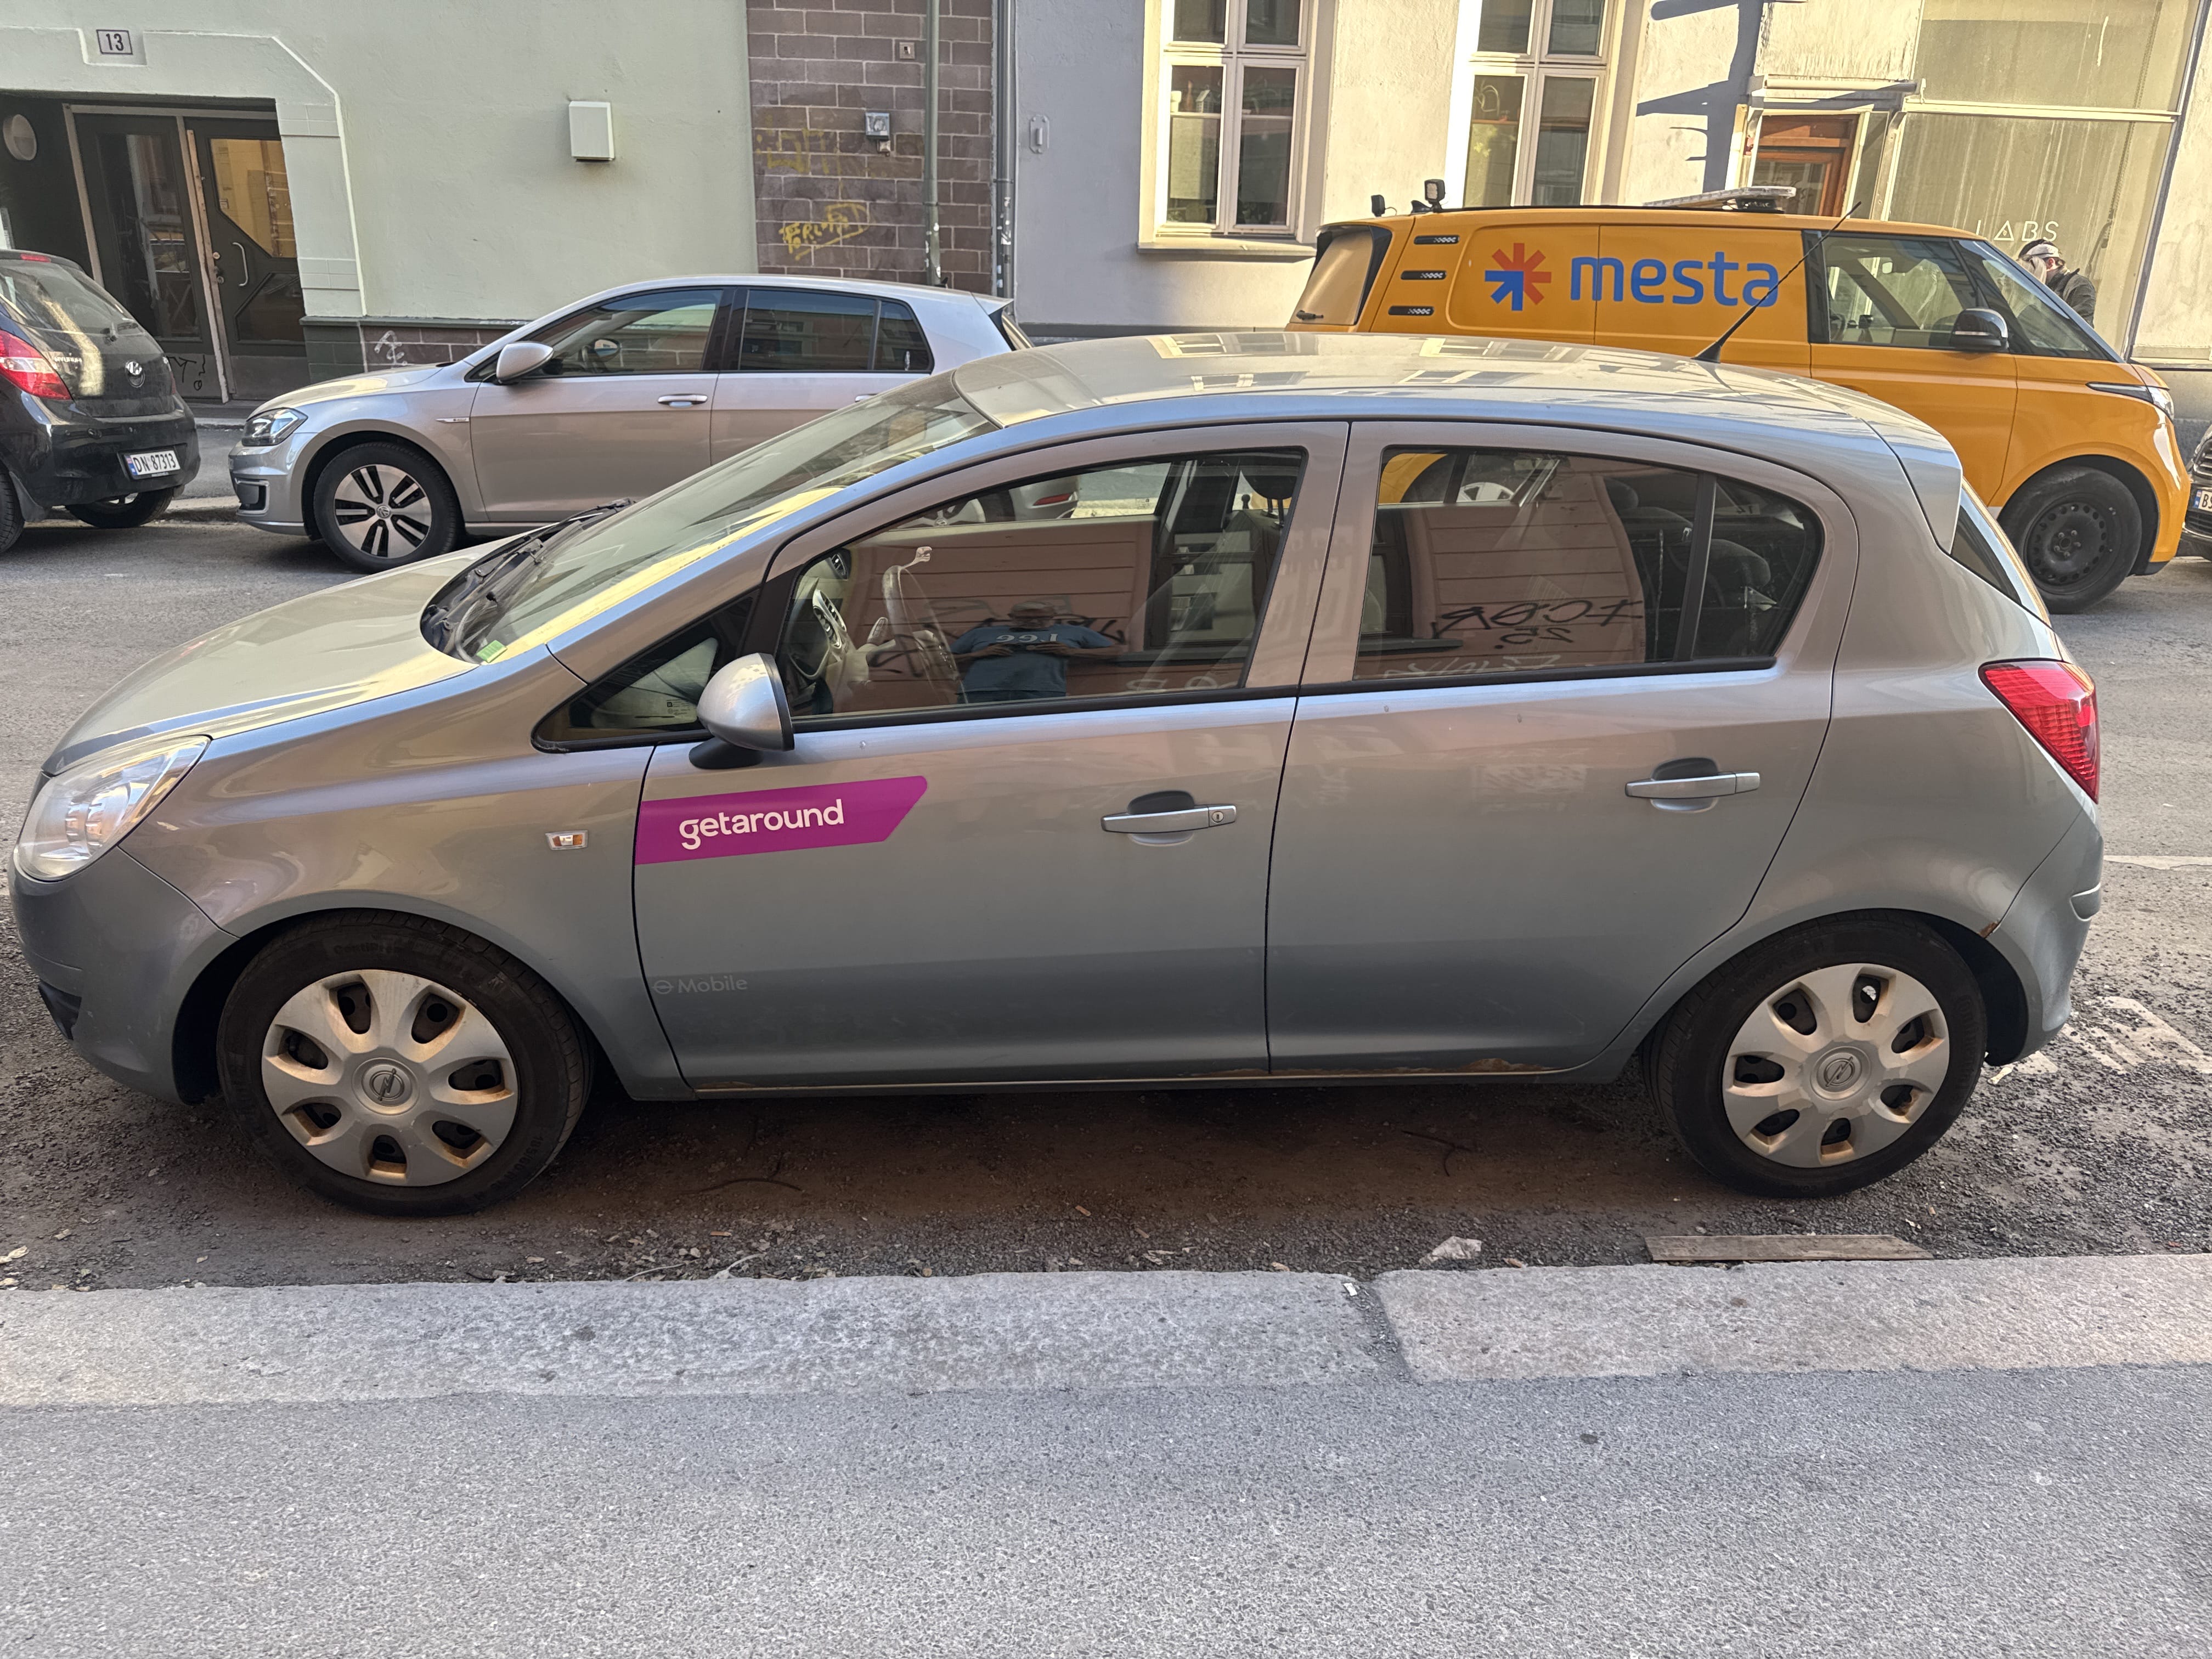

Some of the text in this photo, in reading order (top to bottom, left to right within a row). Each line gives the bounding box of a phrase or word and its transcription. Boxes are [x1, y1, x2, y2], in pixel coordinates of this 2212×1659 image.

[106, 33, 123, 50] 13
[1570, 251, 1779, 307] mesta
[133, 453, 176, 472] DN 87313
[679, 798, 844, 850] getaround
[677, 975, 748, 994] Mobile
